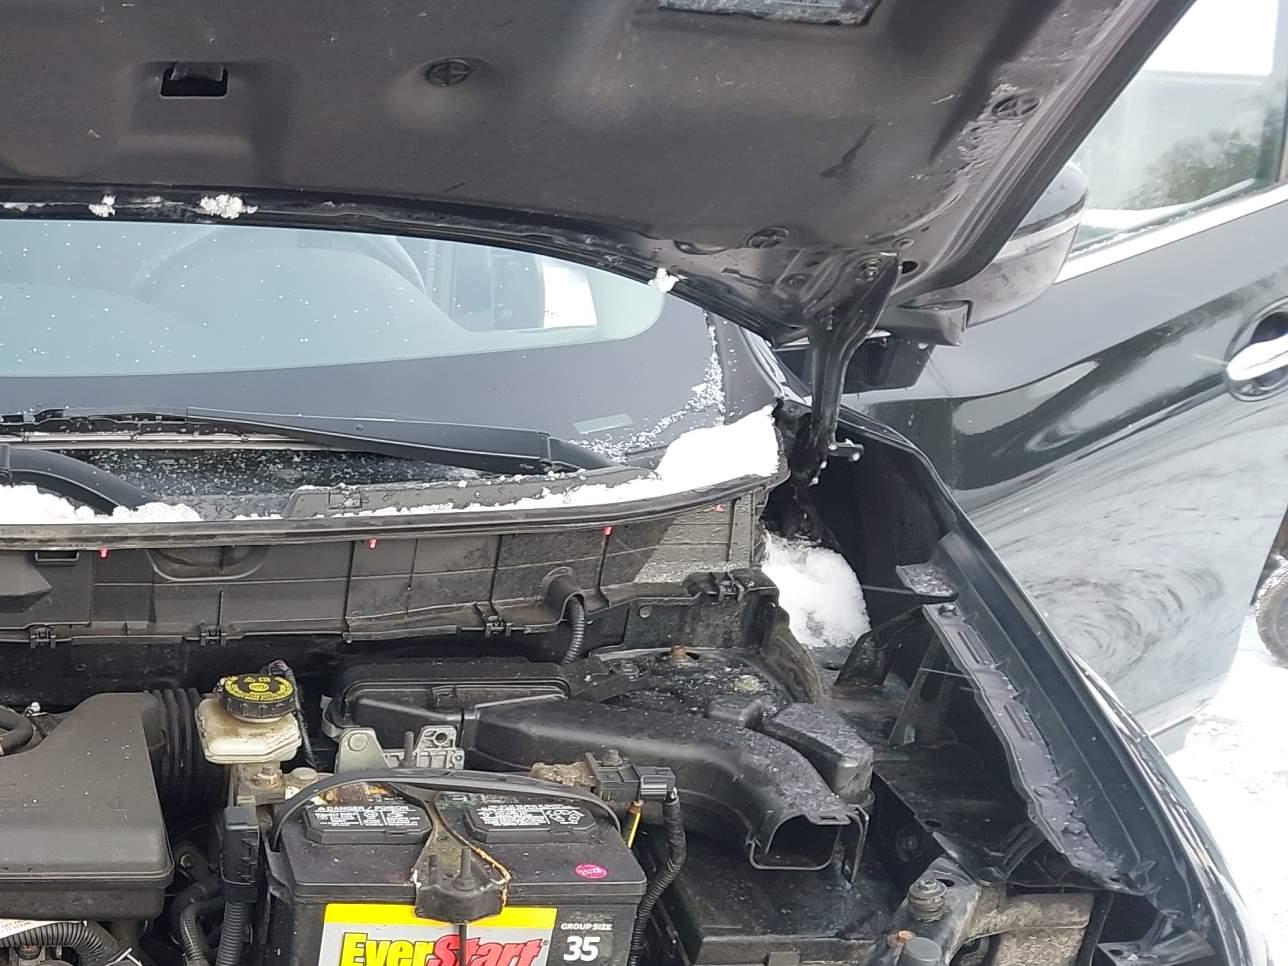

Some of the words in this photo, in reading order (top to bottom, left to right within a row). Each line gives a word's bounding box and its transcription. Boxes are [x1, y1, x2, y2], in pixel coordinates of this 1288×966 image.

[561, 922, 591, 930] GROUP
[592, 923, 613, 931] SIZE
[563, 936, 601, 961] 35
